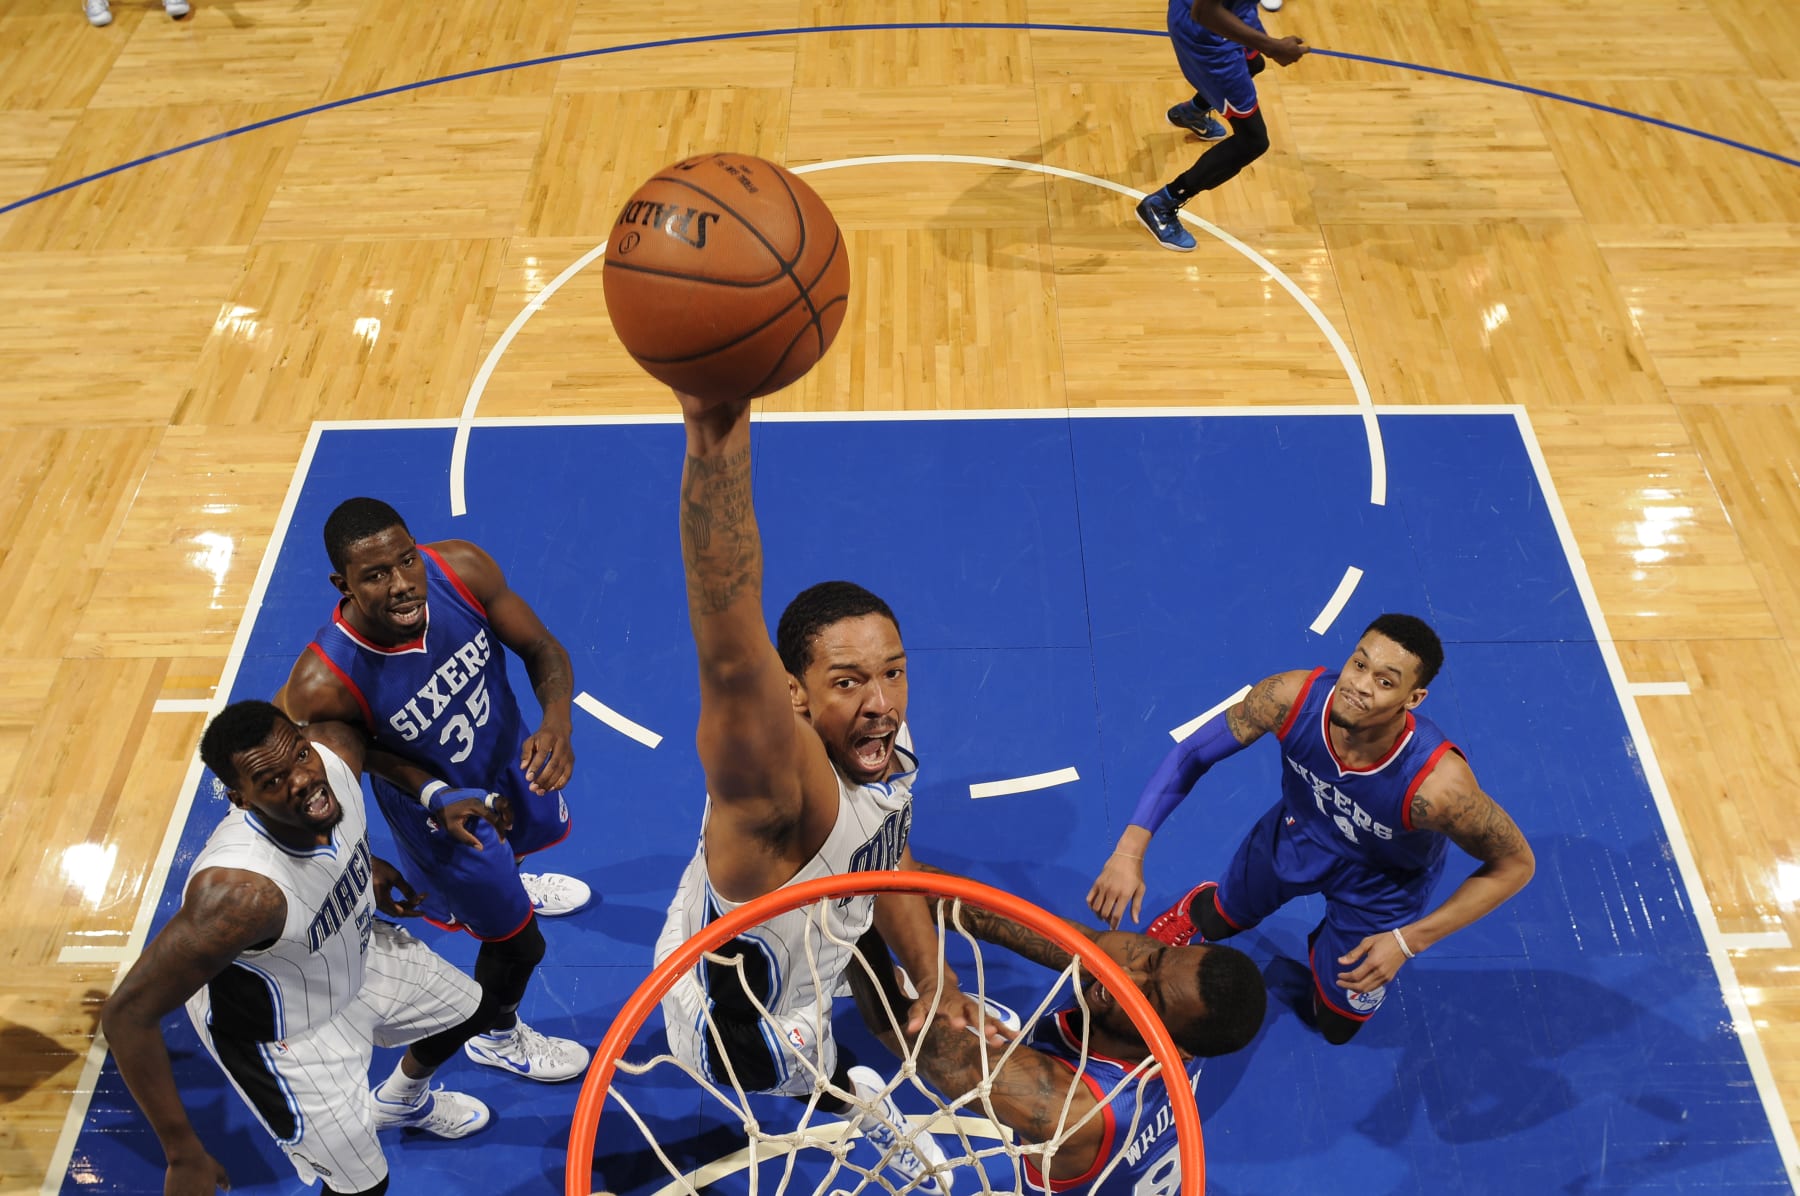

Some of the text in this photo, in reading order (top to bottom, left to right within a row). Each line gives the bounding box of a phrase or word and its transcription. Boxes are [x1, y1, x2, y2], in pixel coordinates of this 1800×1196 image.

[389, 628, 492, 742] SIXERS
[439, 674, 491, 764] 35
[1313, 791, 1360, 845] 14
[307, 830, 373, 954] MAGI
